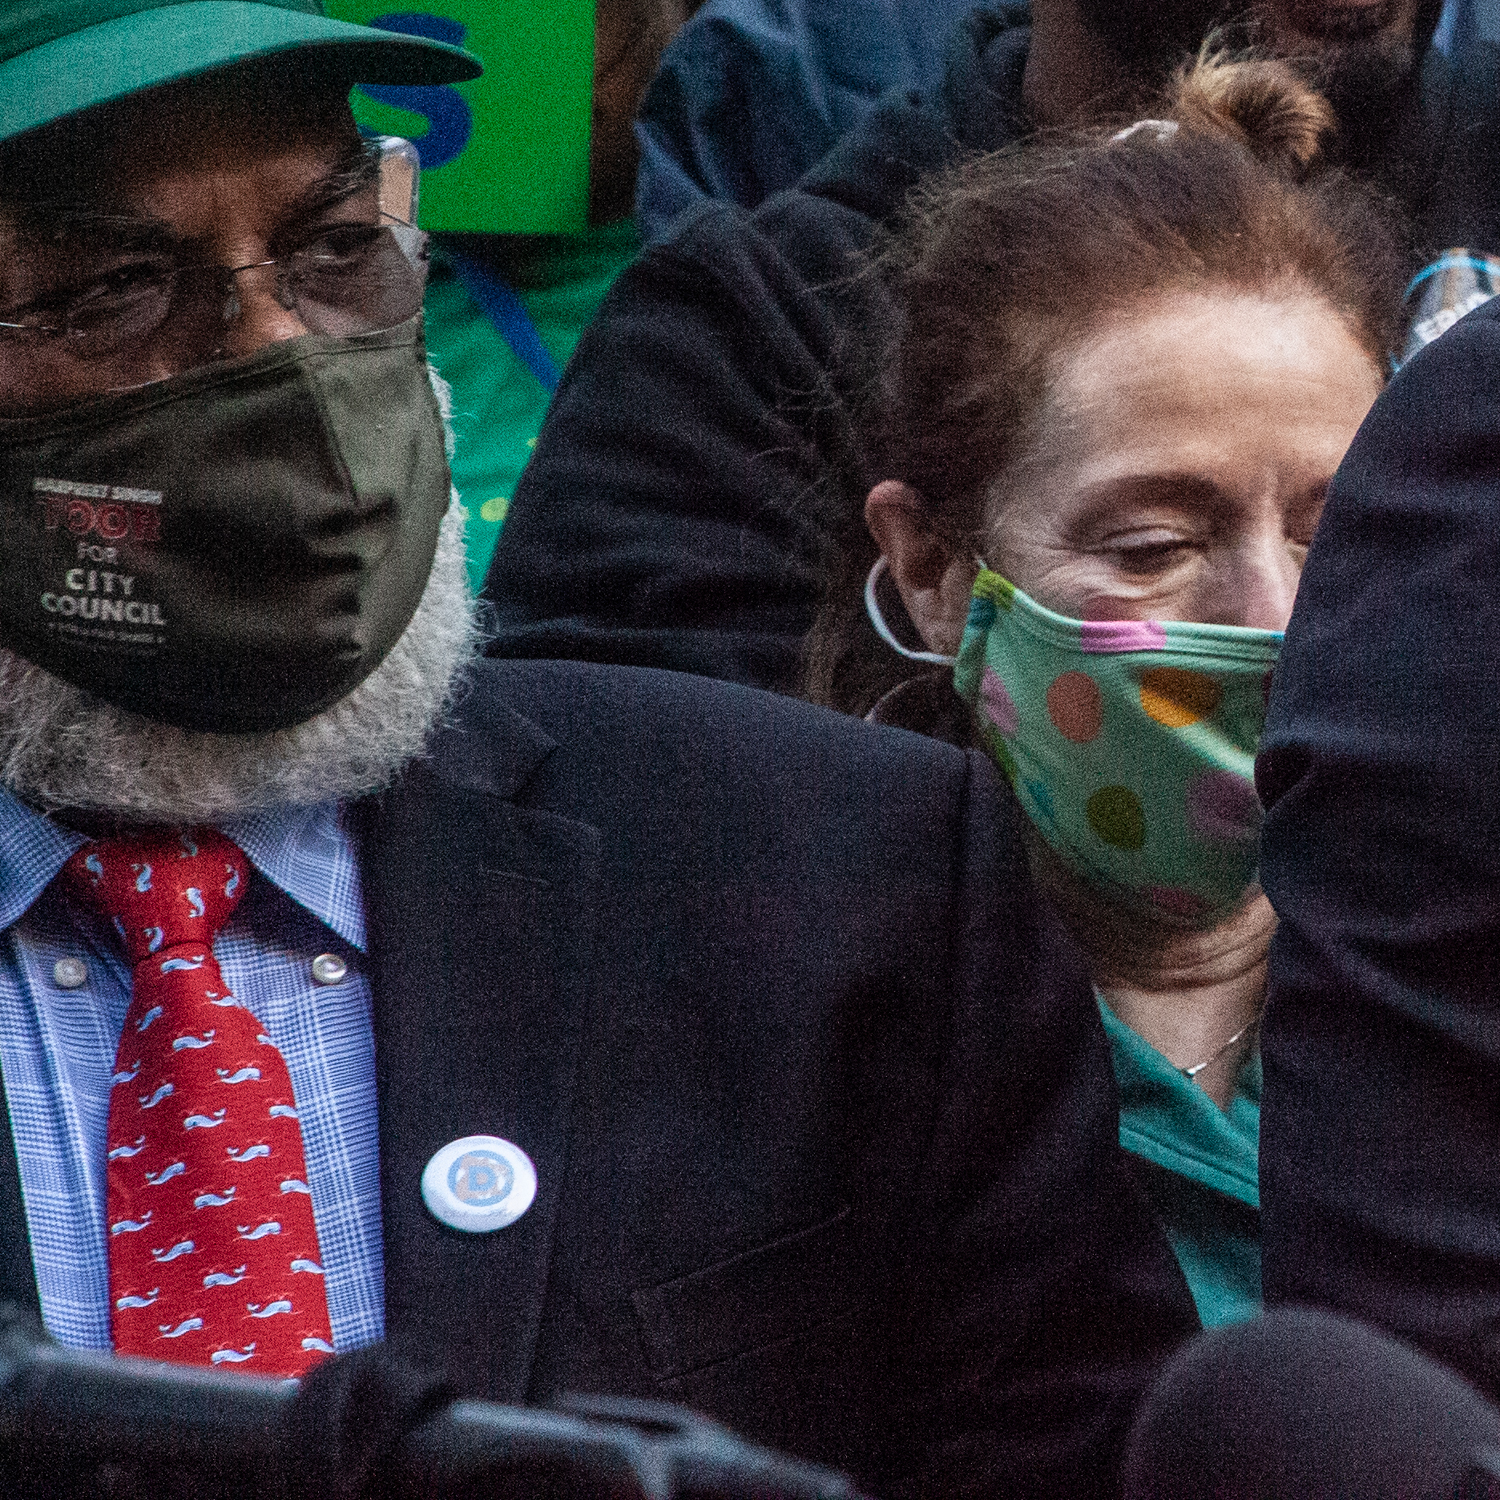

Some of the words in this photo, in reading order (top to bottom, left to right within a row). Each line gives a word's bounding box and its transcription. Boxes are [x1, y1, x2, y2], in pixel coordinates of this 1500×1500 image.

[77, 541, 119, 565] FOR
[65, 568, 135, 596] CITY
[40, 592, 167, 626] COUNCIL
